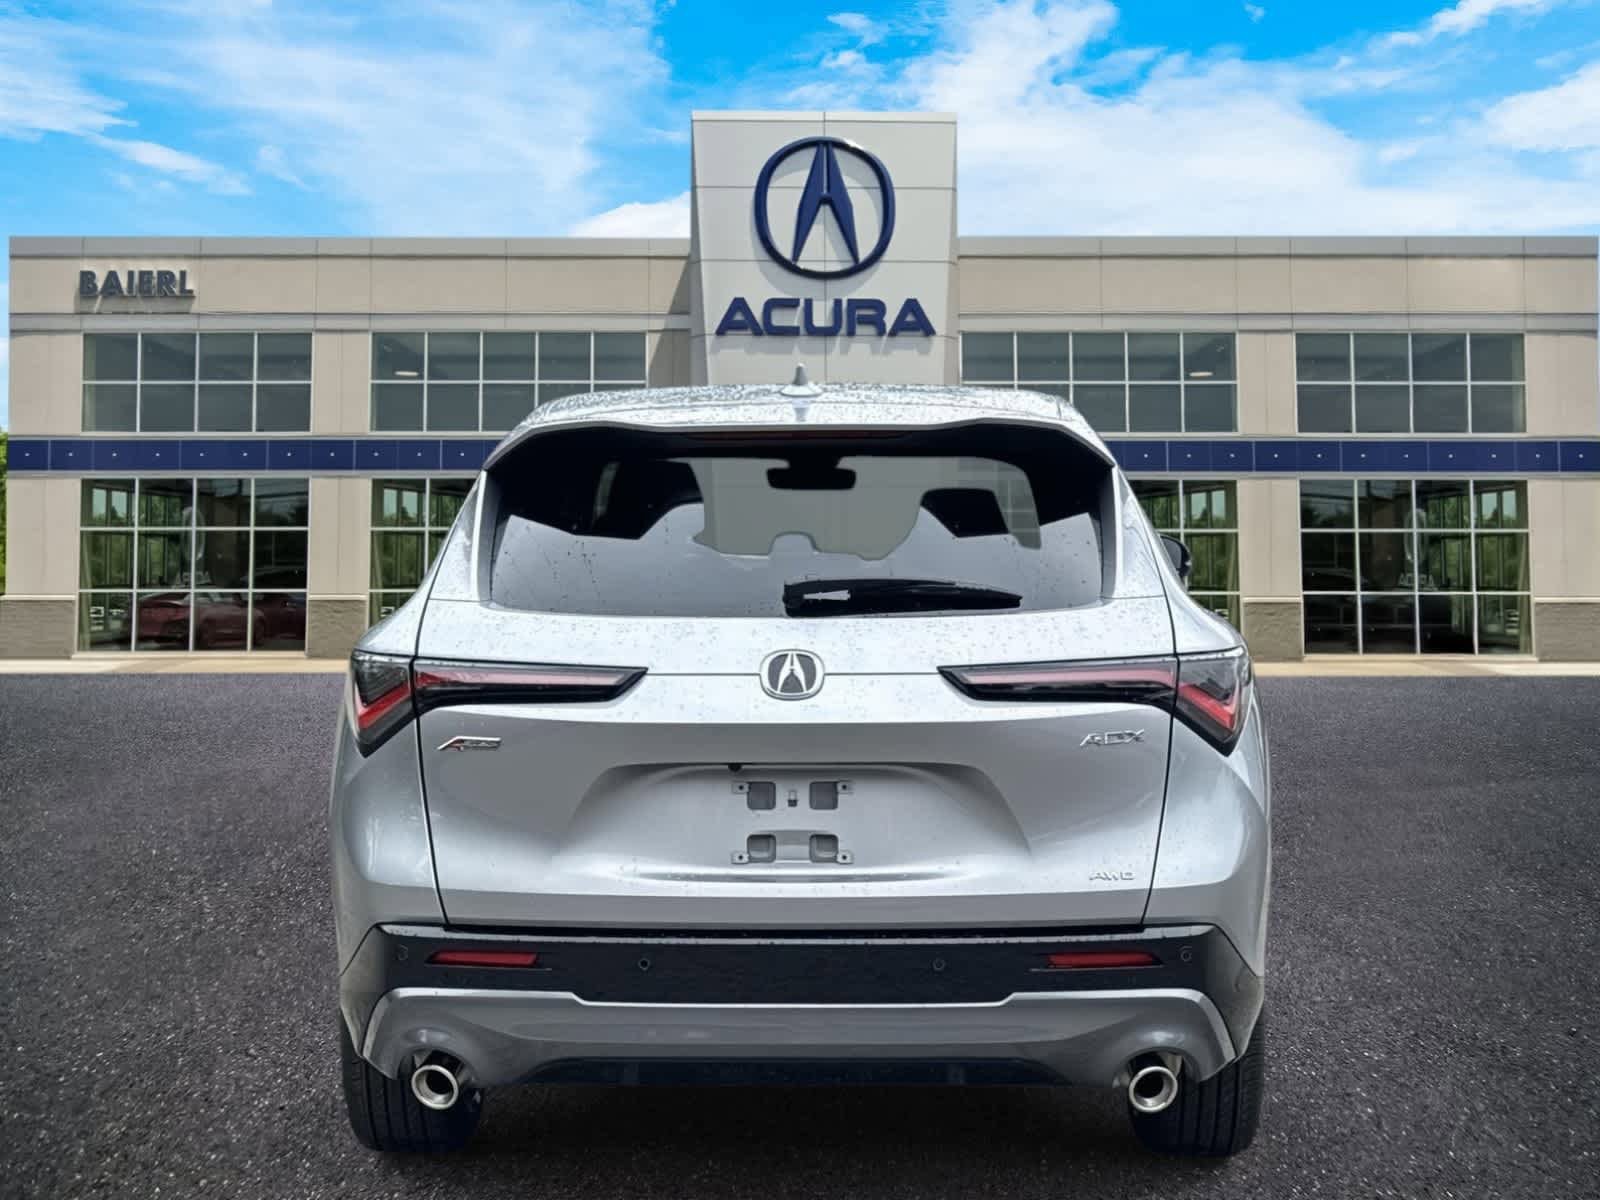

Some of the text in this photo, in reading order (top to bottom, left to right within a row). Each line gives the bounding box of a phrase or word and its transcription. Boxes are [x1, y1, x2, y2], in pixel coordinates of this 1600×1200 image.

[79, 270, 194, 296] BAIERL
[715, 297, 936, 336] ACURA
[1079, 728, 1145, 746] ADX
